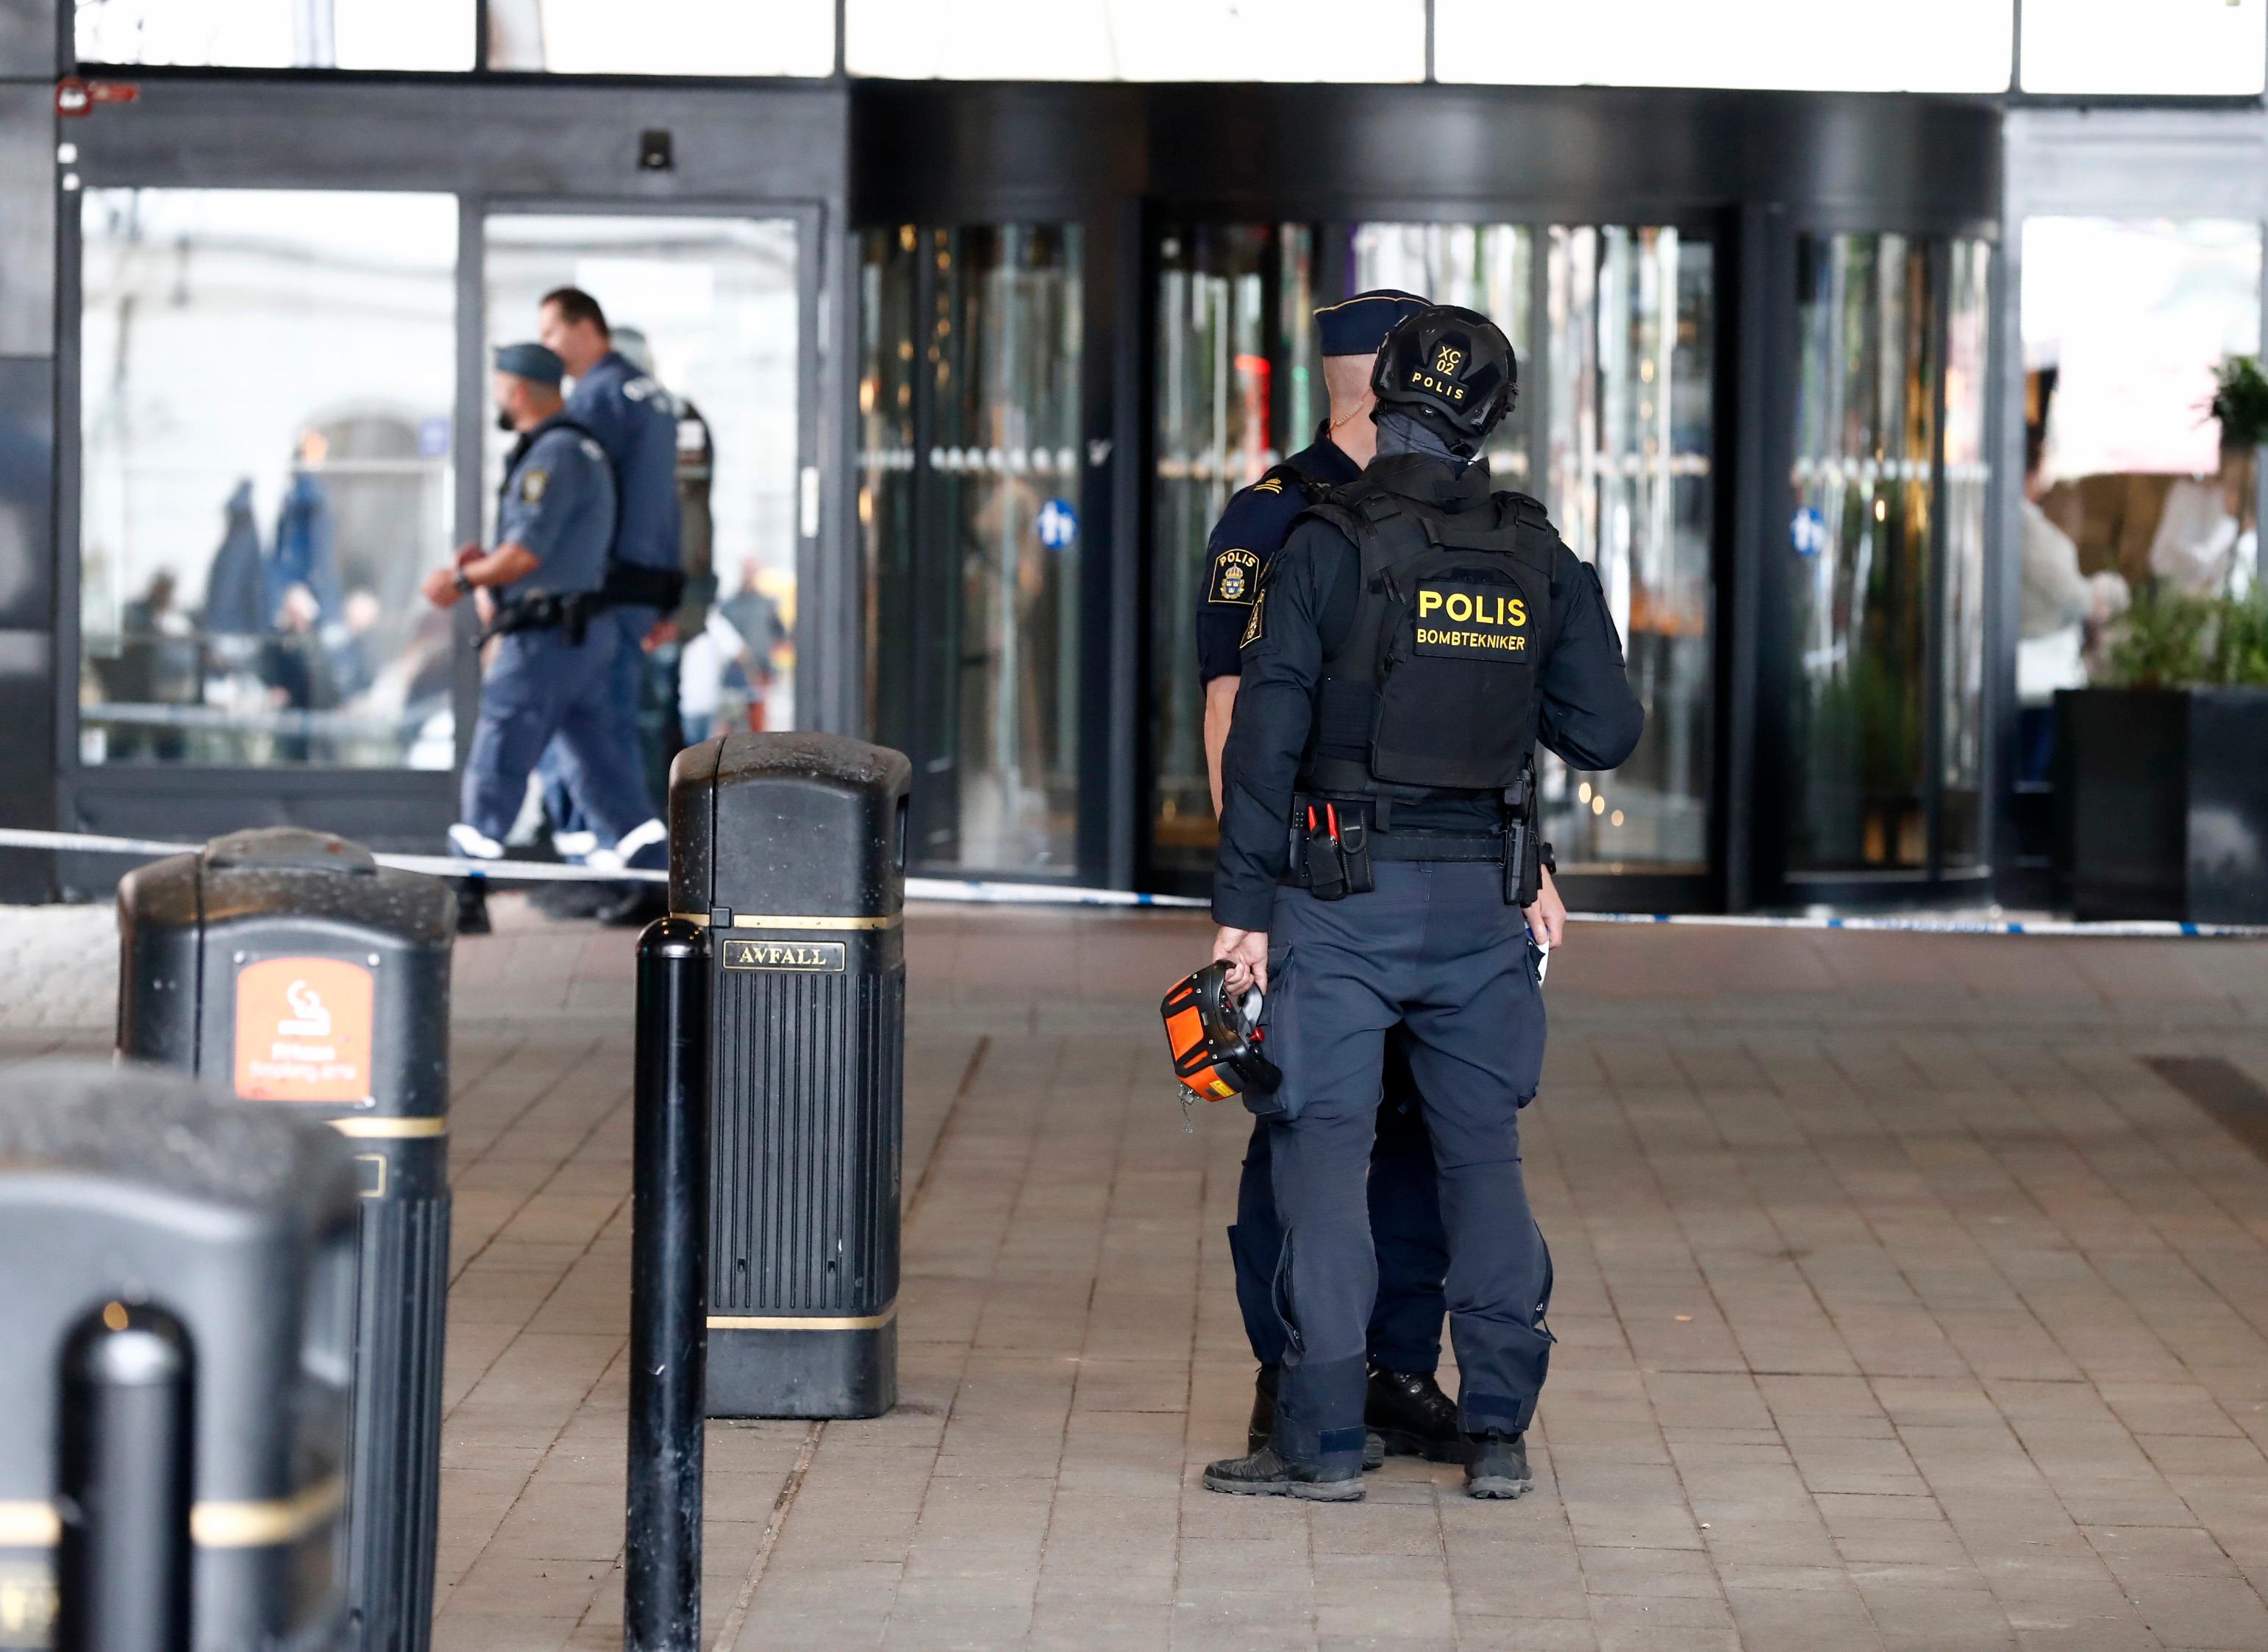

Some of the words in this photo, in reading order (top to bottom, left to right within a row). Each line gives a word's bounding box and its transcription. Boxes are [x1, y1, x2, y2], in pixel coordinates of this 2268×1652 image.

[1438, 346, 1461, 363] XC
[1436, 359, 1455, 376] 02
[1412, 372, 1463, 399] POLIS
[1219, 552, 1256, 567] POLIS
[1419, 590, 1527, 627] POLIS
[1417, 628, 1525, 650] BOMBTEKNIKER
[739, 947, 827, 965] AVFALL
